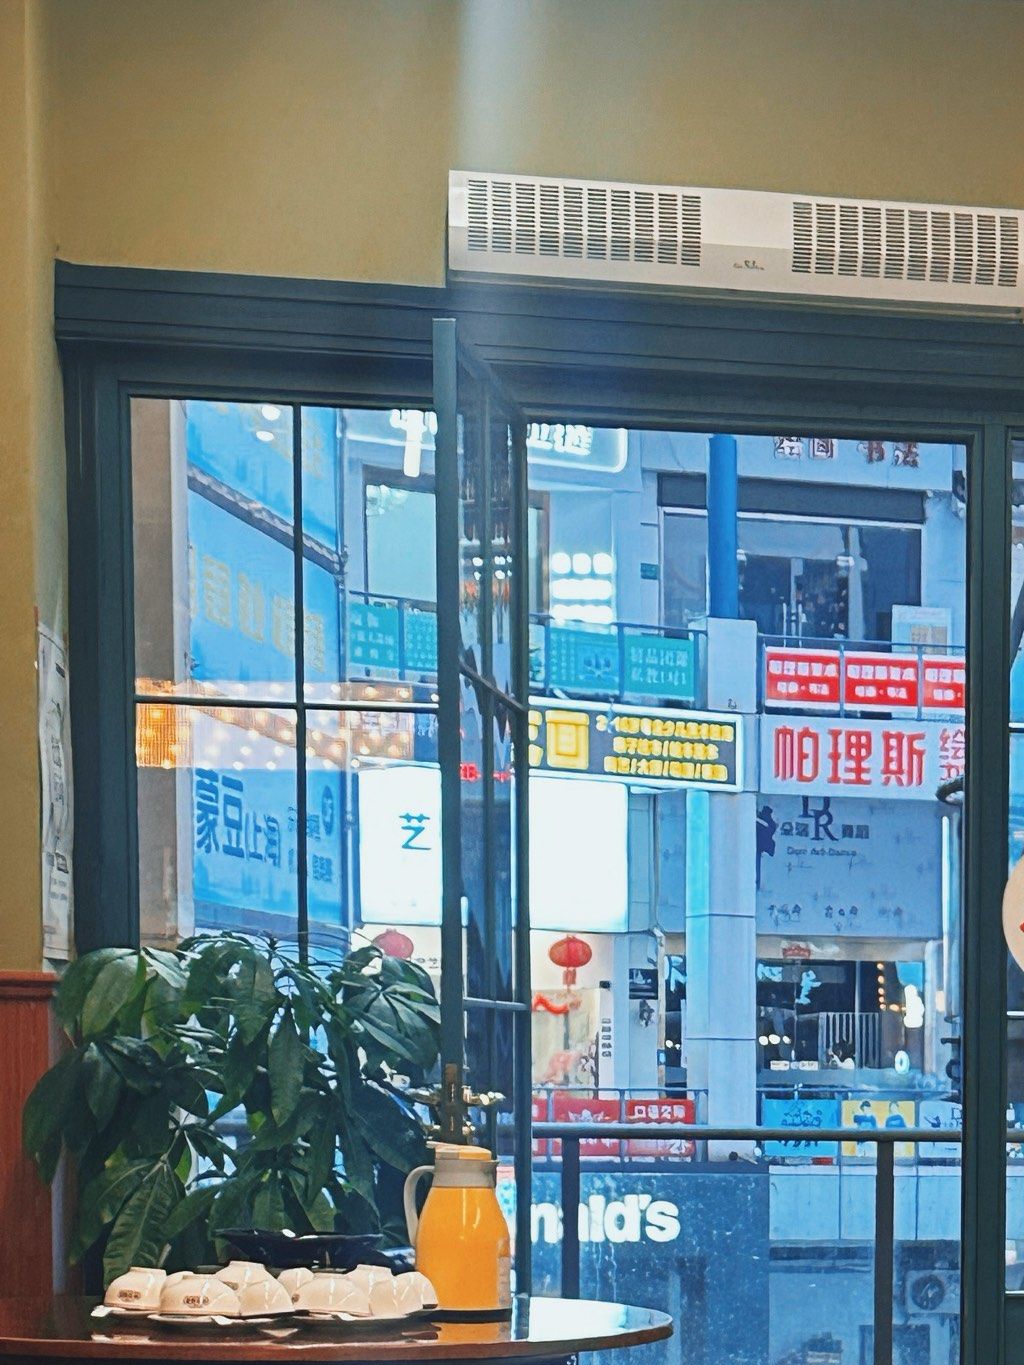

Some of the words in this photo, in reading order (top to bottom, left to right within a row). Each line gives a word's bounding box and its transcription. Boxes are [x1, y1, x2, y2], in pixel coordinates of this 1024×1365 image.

[774, 725, 926, 787] 帕理斯
[399, 813, 431, 850] 艺
